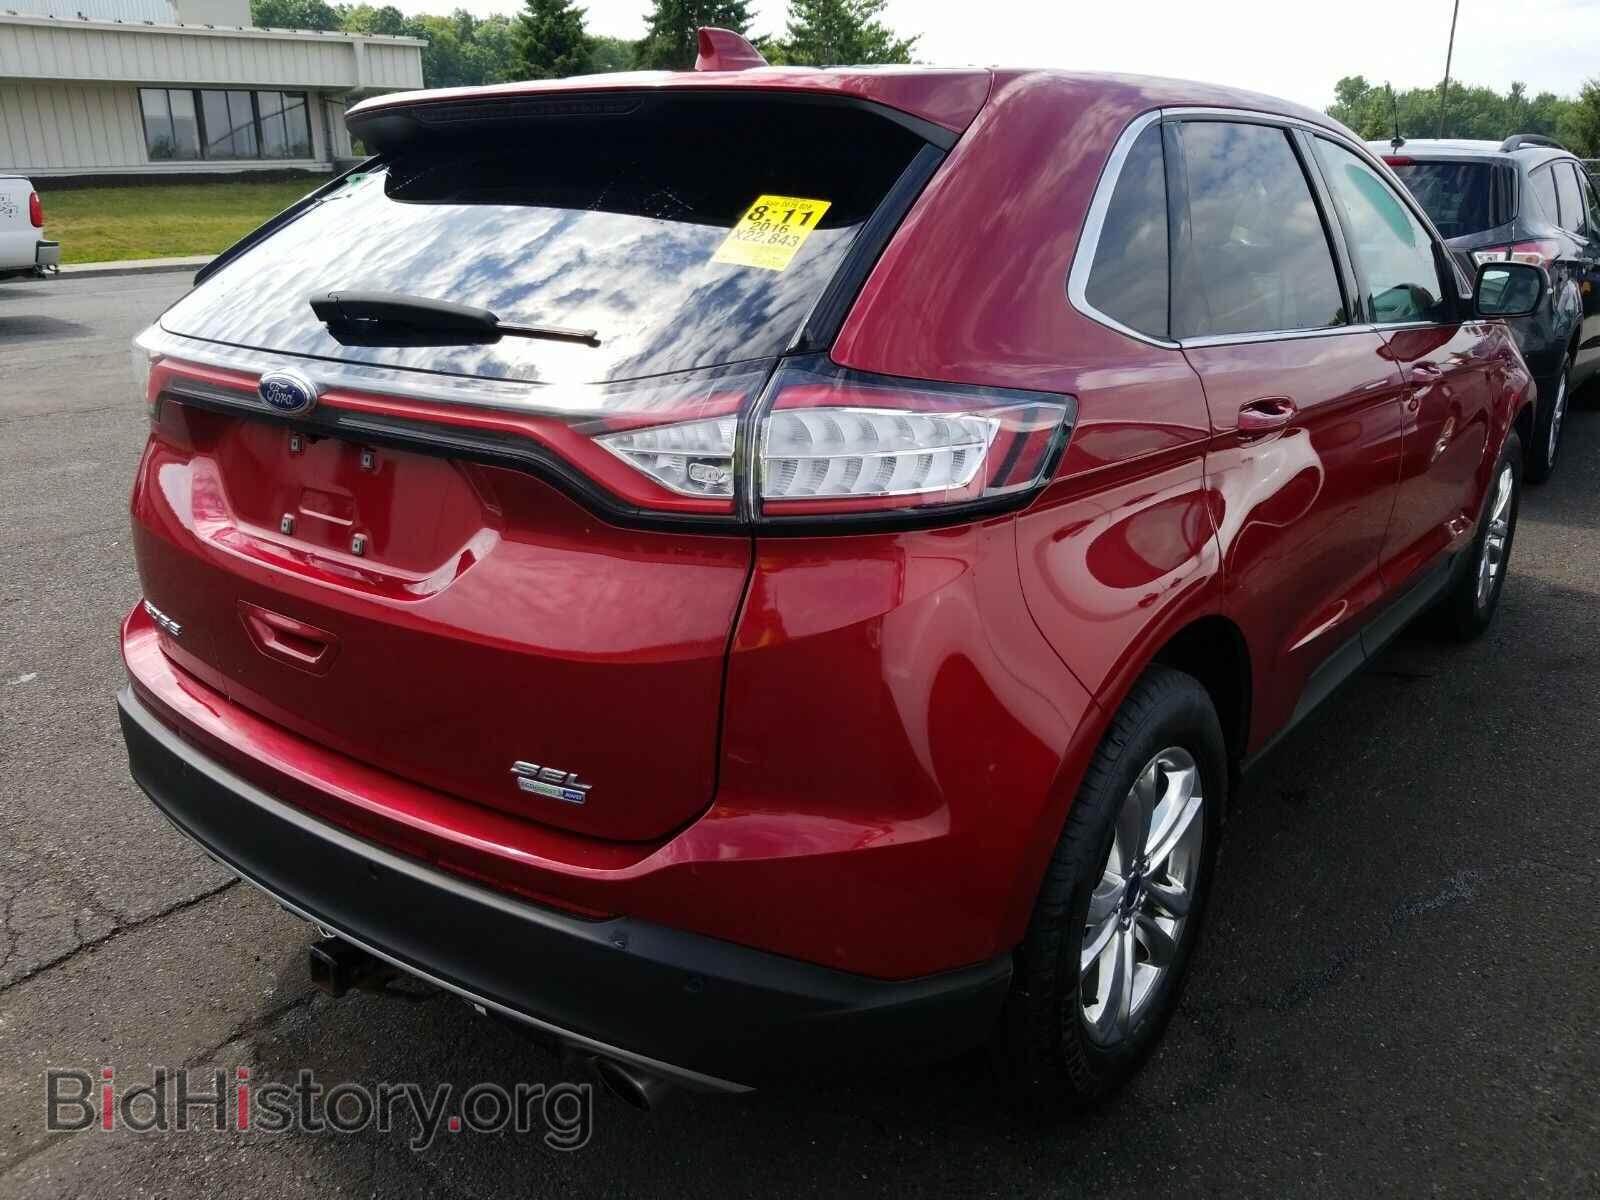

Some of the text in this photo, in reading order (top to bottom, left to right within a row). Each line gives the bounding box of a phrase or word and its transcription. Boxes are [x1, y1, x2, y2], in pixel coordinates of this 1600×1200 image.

[749, 221, 790, 234] 2016
[266, 381, 293, 405] Ford
[510, 760, 592, 789] SEL
